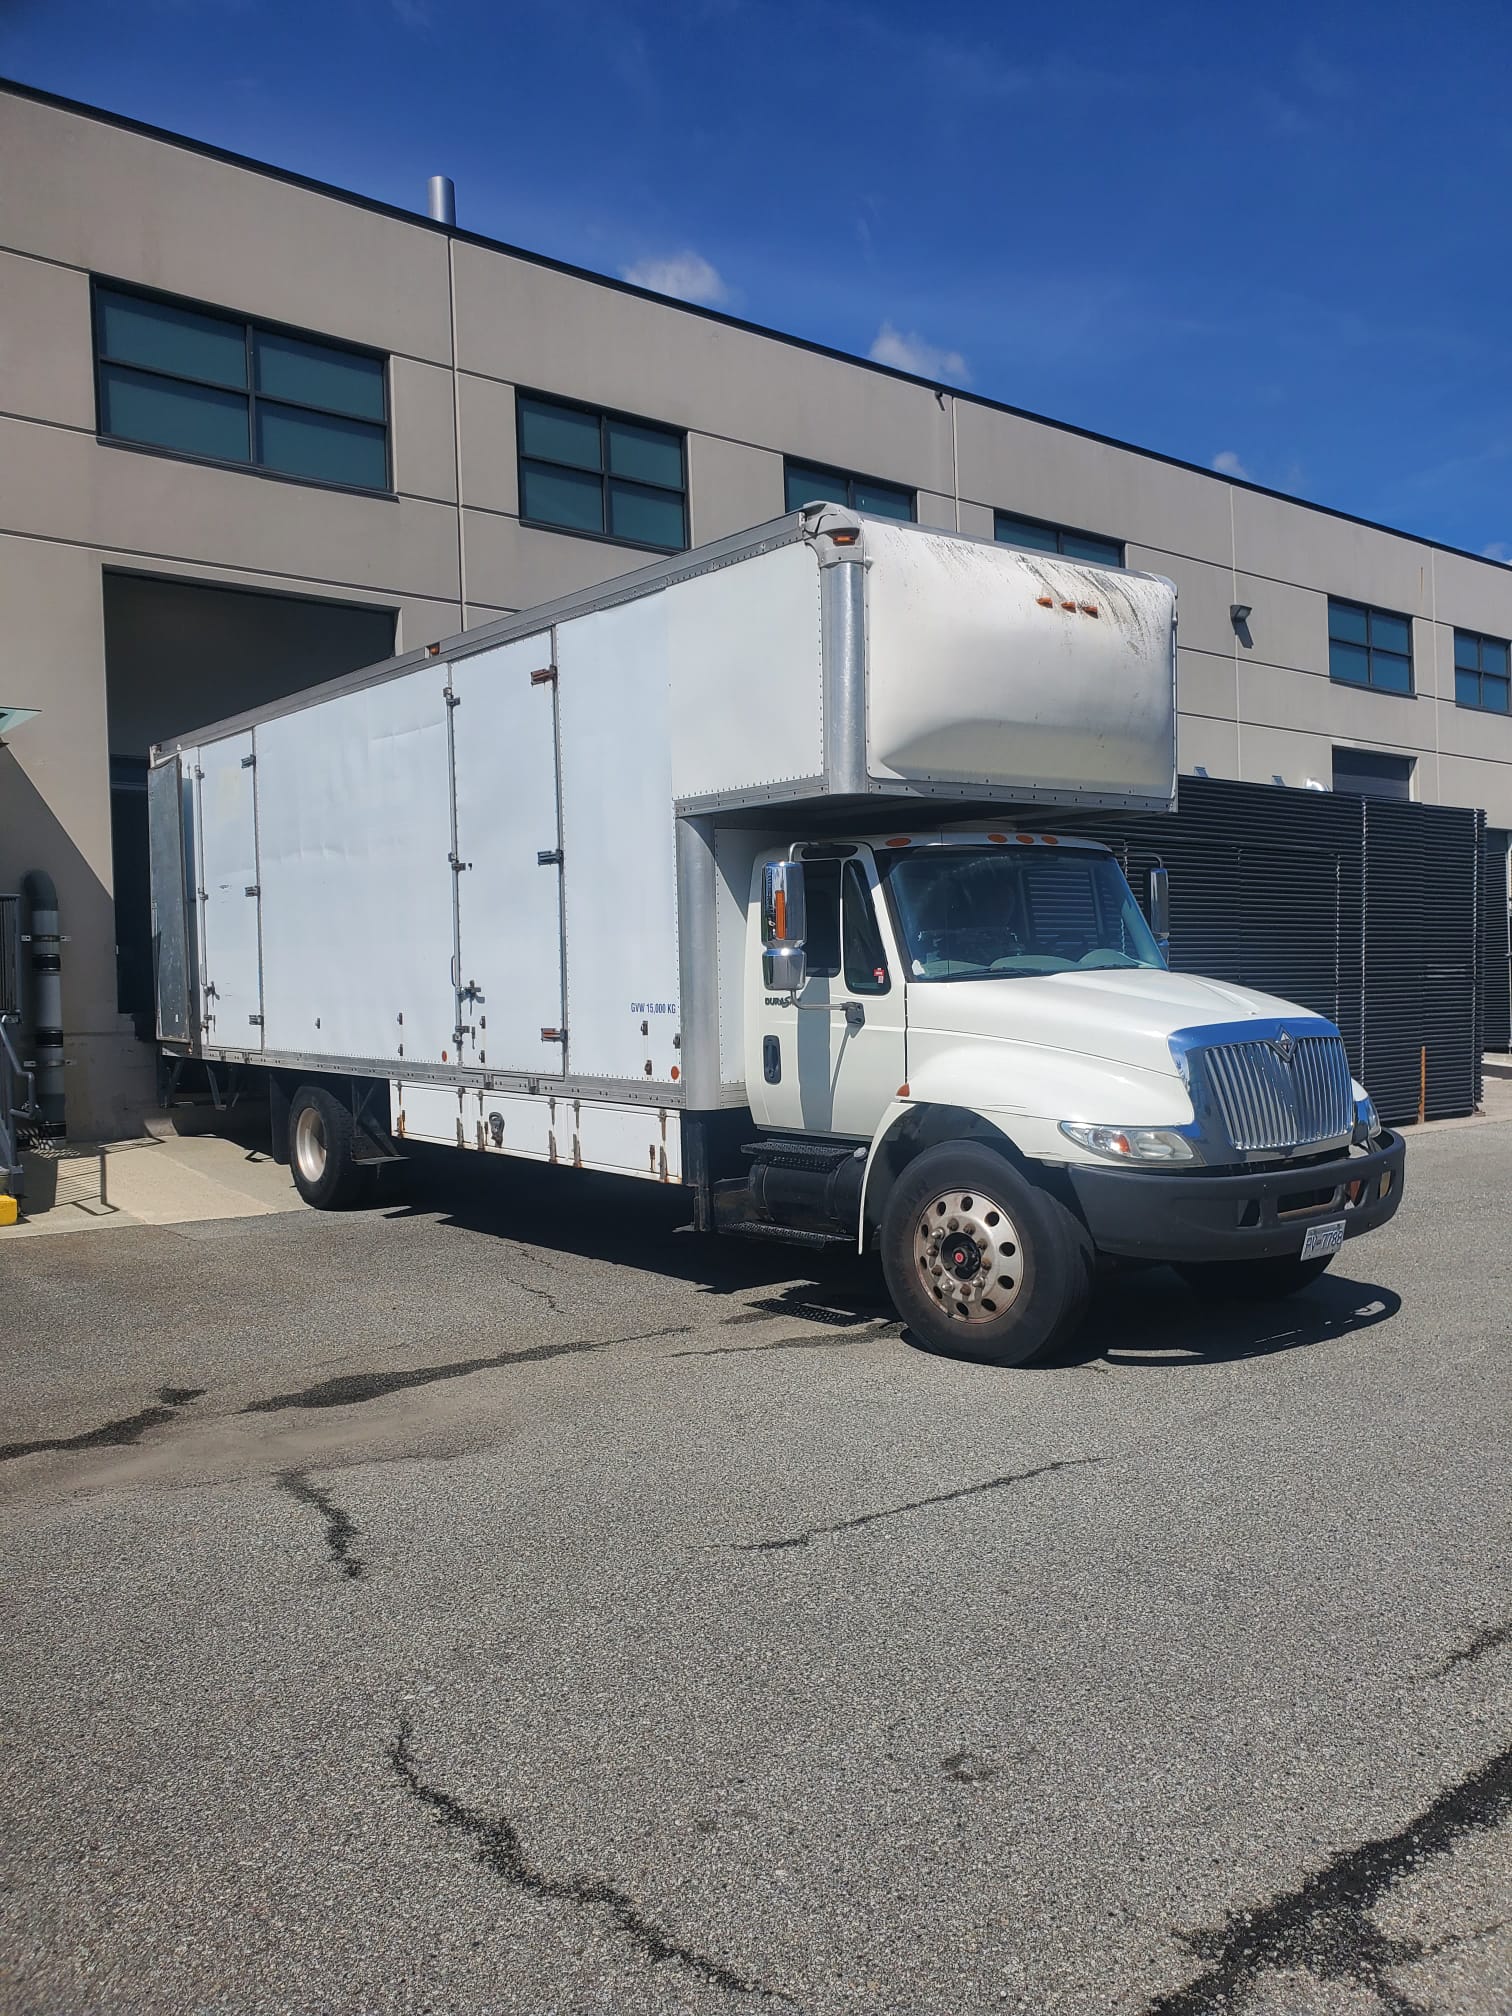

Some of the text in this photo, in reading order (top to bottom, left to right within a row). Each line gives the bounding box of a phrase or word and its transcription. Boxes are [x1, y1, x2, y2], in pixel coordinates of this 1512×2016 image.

[631, 1002, 676, 1014] GVW 15,000 KG
